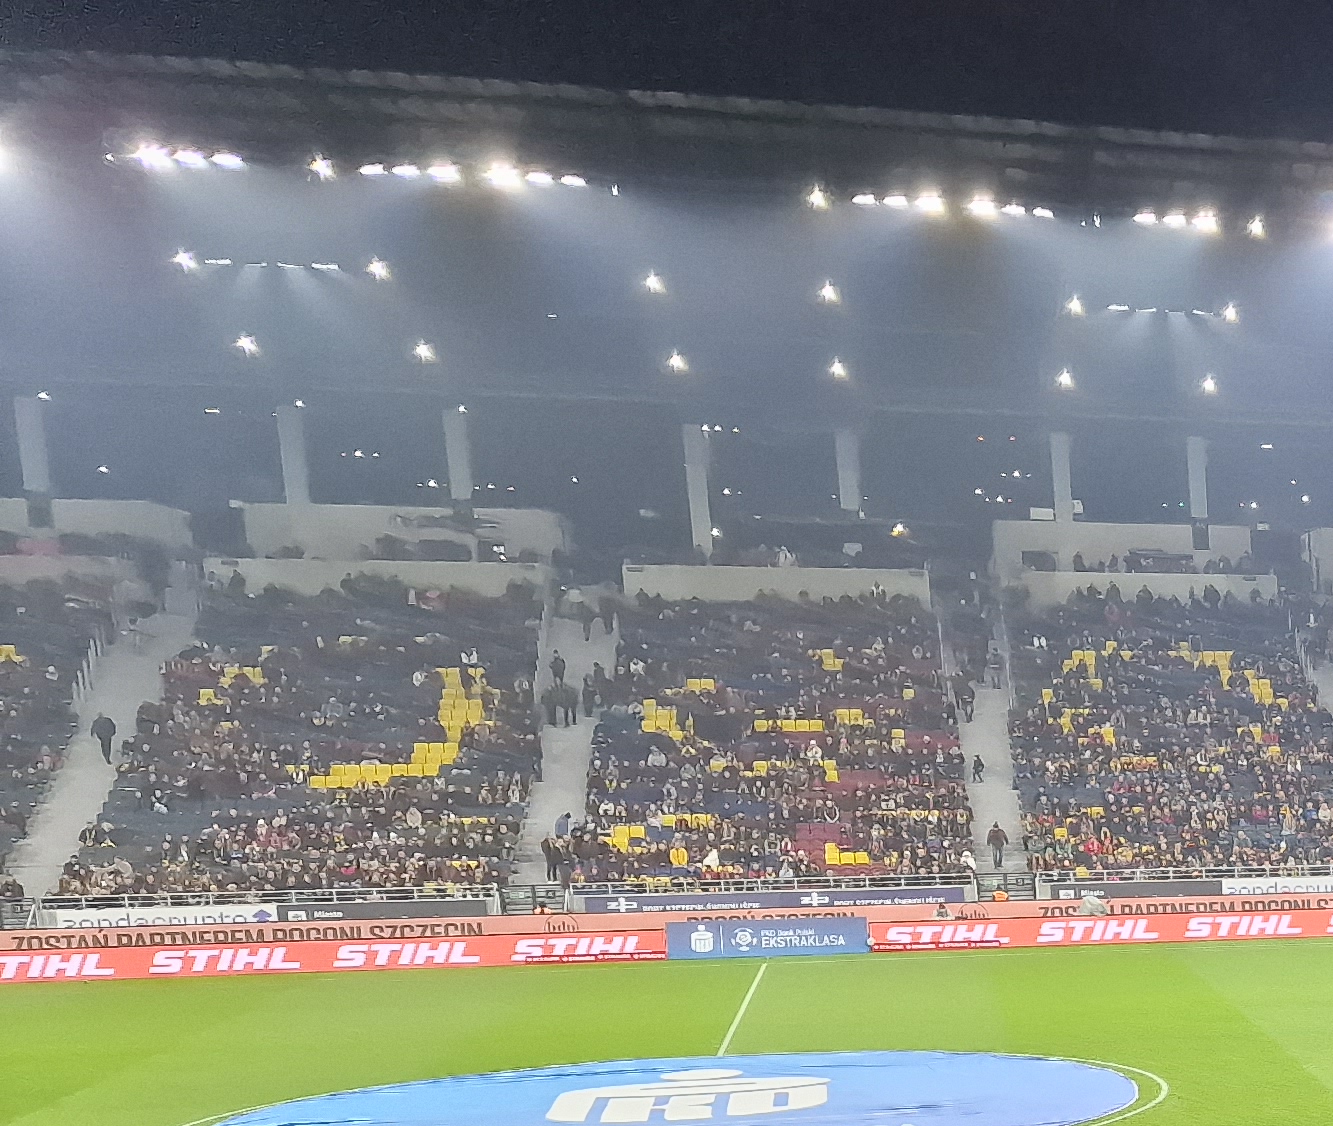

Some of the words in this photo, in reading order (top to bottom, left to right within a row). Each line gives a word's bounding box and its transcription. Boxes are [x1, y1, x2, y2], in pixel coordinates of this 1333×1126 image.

[886, 923, 1010, 944] STIHL
[1036, 919, 1159, 943] STIHL
[1184, 914, 1302, 938] STIHL
[511, 935, 652, 962] STIHL
[761, 934, 846, 949] EKSTRAKLASA
[150, 946, 300, 974] STIHL
[333, 941, 480, 968] STIHL
